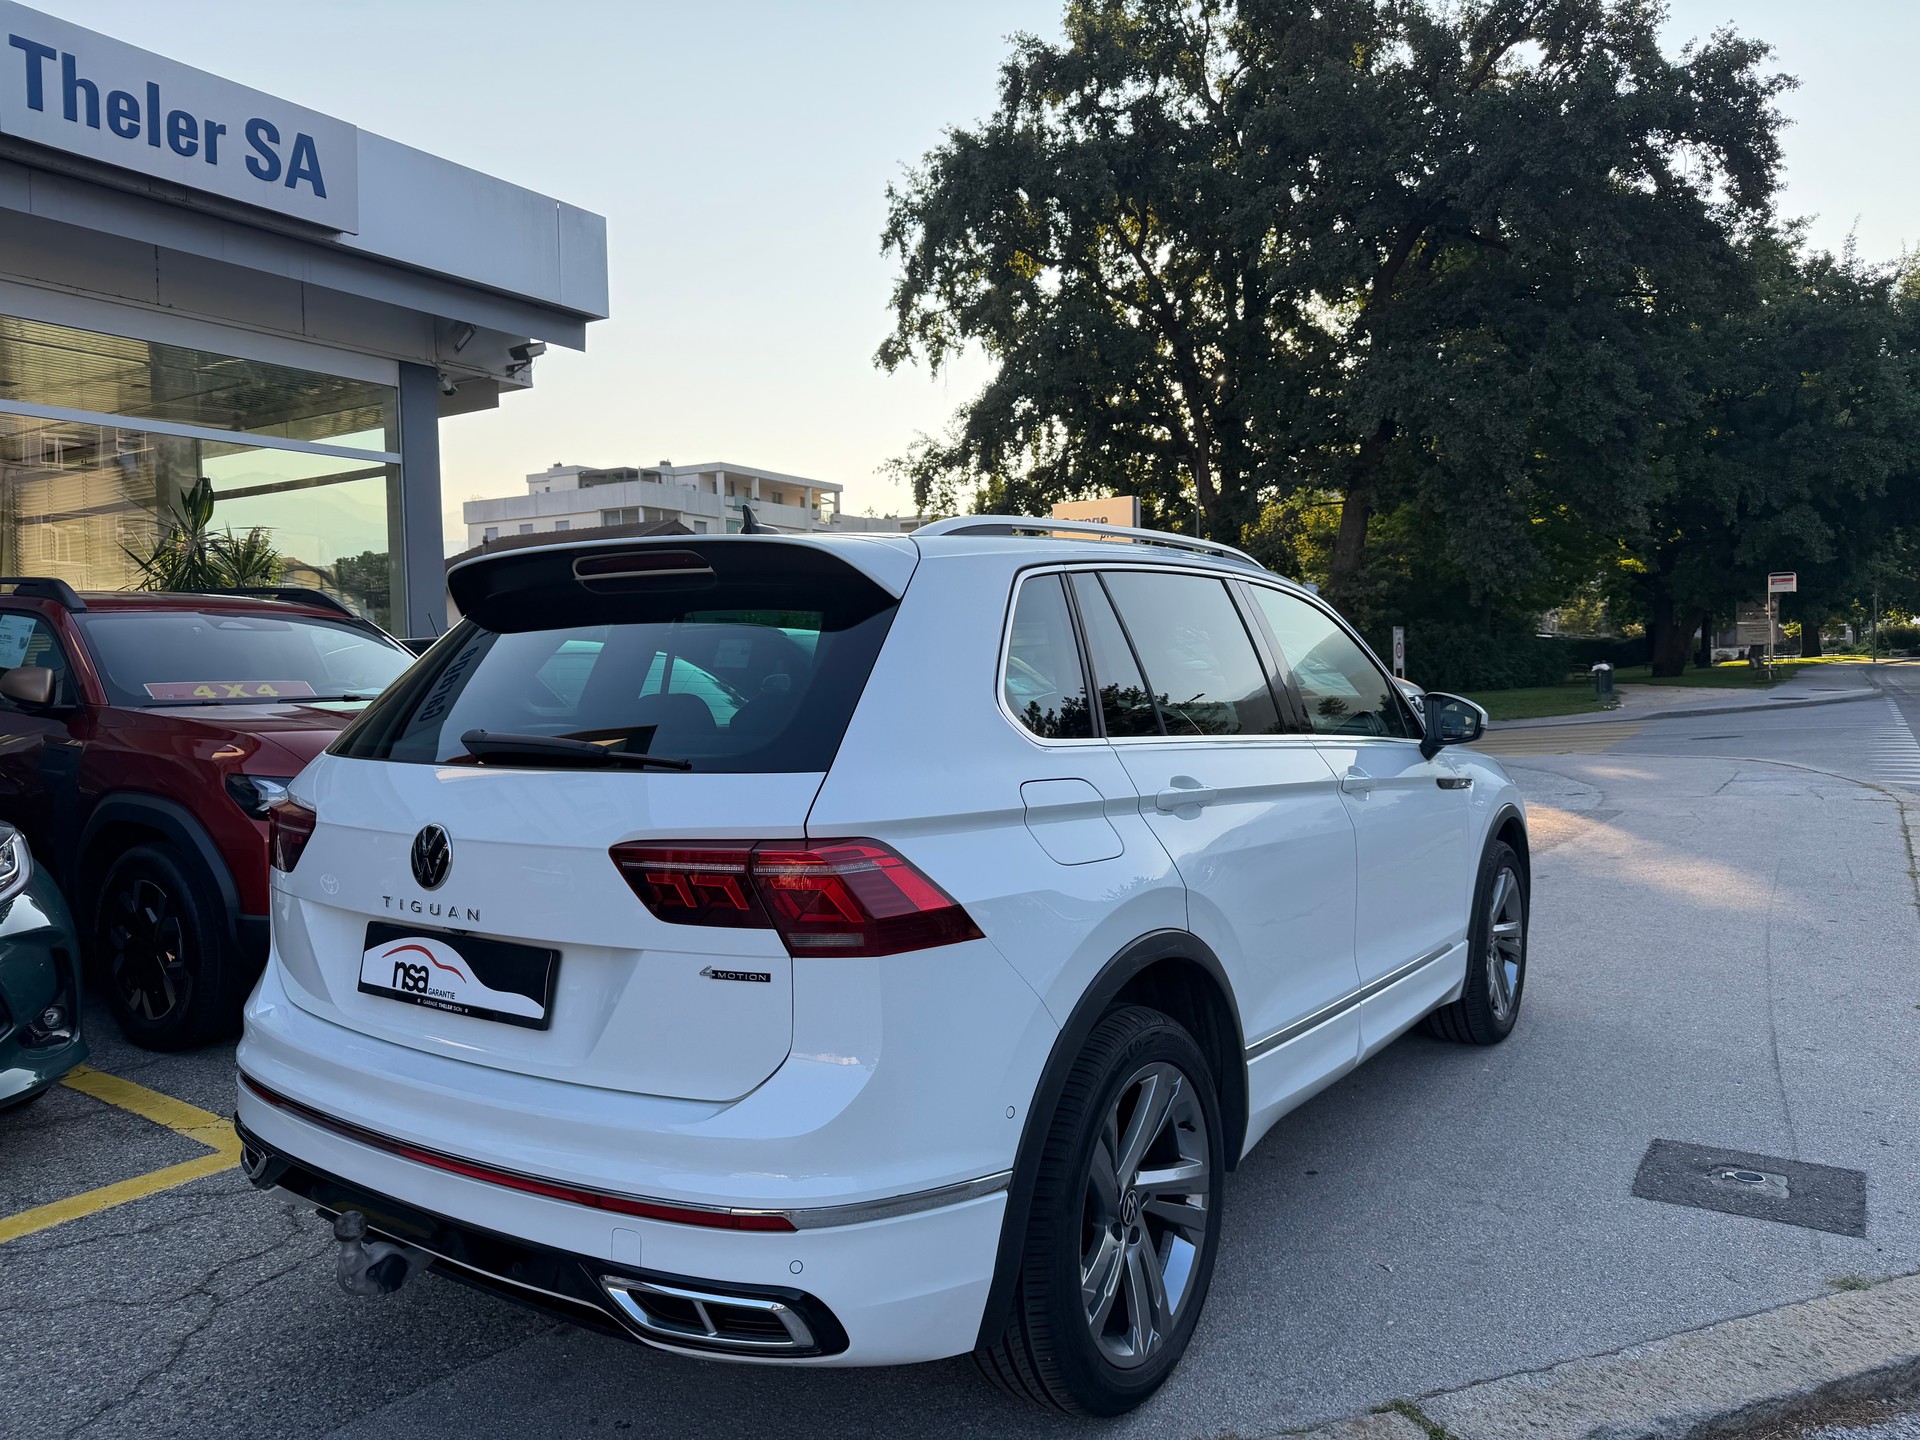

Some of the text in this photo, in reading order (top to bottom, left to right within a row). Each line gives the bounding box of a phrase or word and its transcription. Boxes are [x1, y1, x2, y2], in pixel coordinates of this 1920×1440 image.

[9, 33, 327, 199] Theler SA
[382, 895, 481, 922] TIGUAN
[392, 961, 429, 994] nsa
[428, 988, 456, 999] GARANTIE
